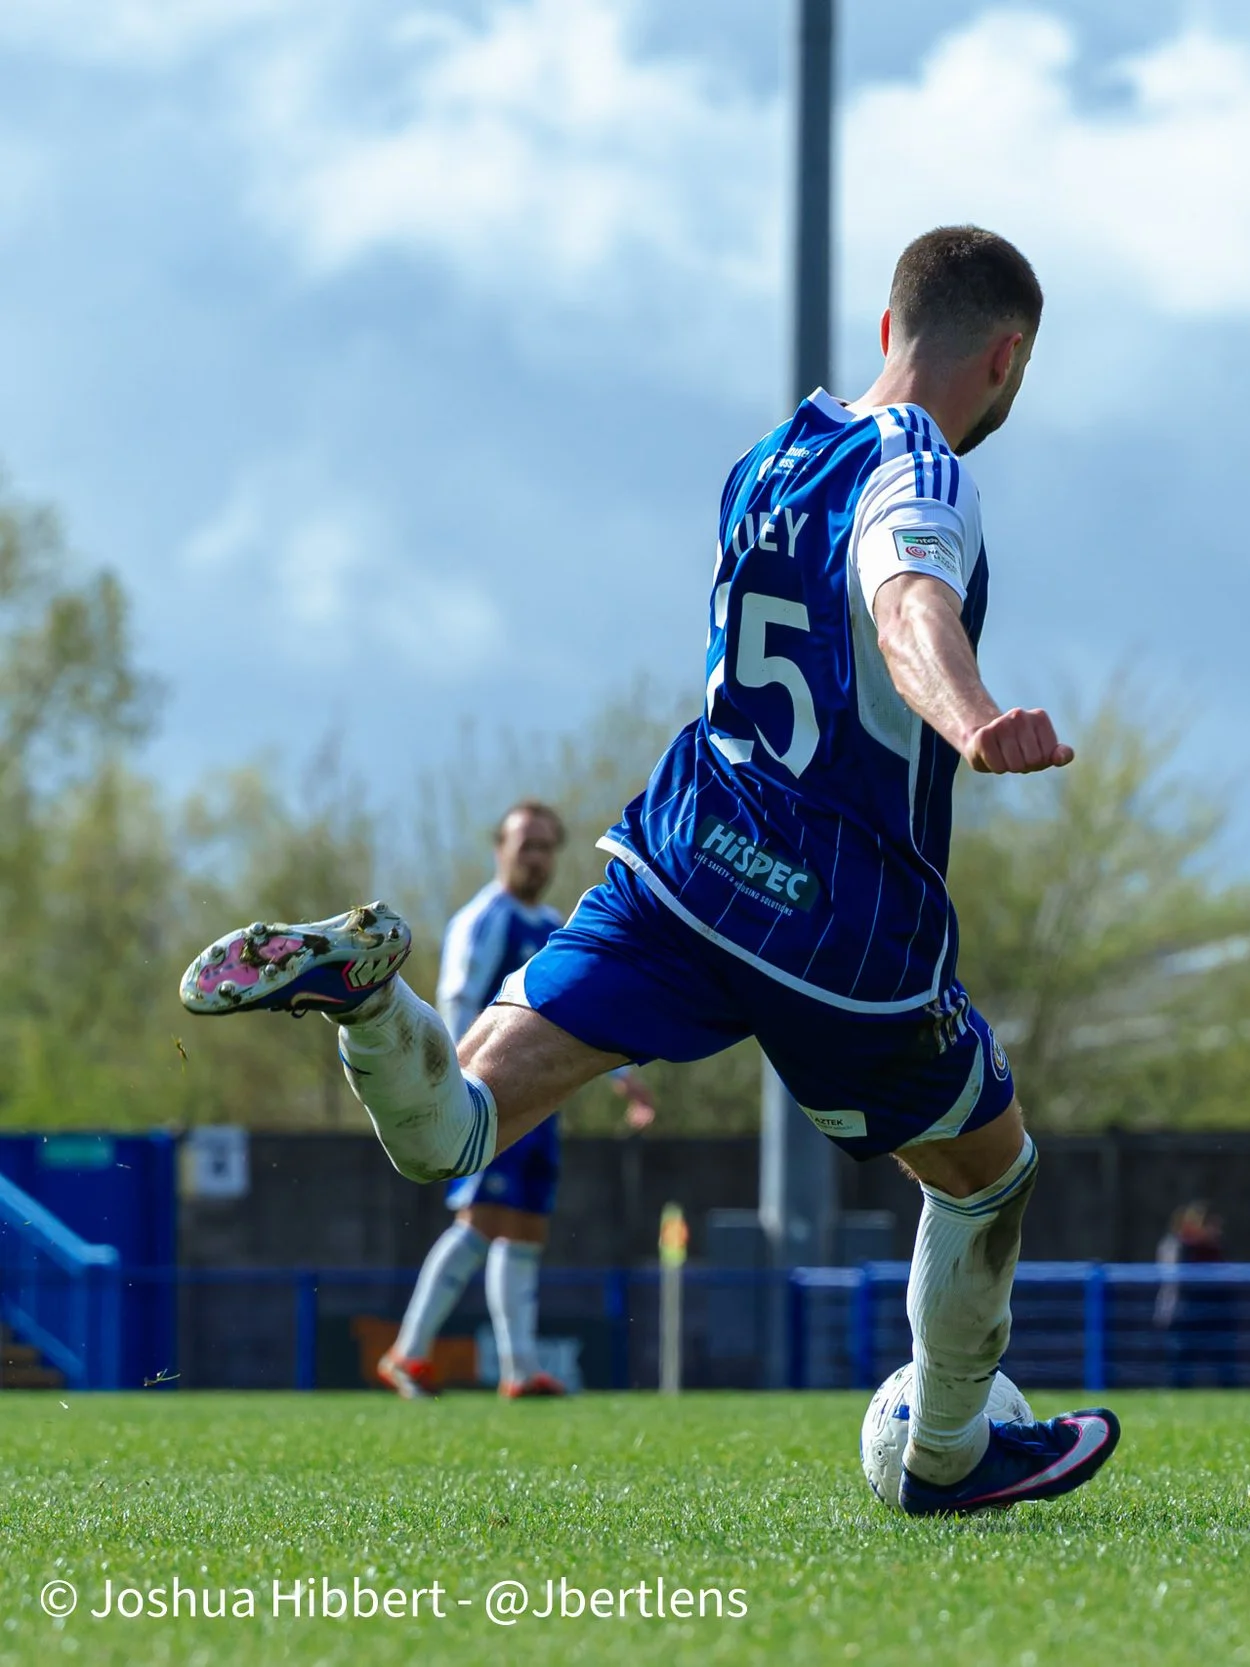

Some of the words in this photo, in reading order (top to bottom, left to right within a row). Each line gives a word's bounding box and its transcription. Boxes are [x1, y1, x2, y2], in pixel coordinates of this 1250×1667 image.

[702, 824, 808, 901] HiSPEC
[707, 860, 730, 878] SAFETY
[760, 895, 793, 917] SOLUTIONS
[815, 1117, 844, 1126] AZTEK
